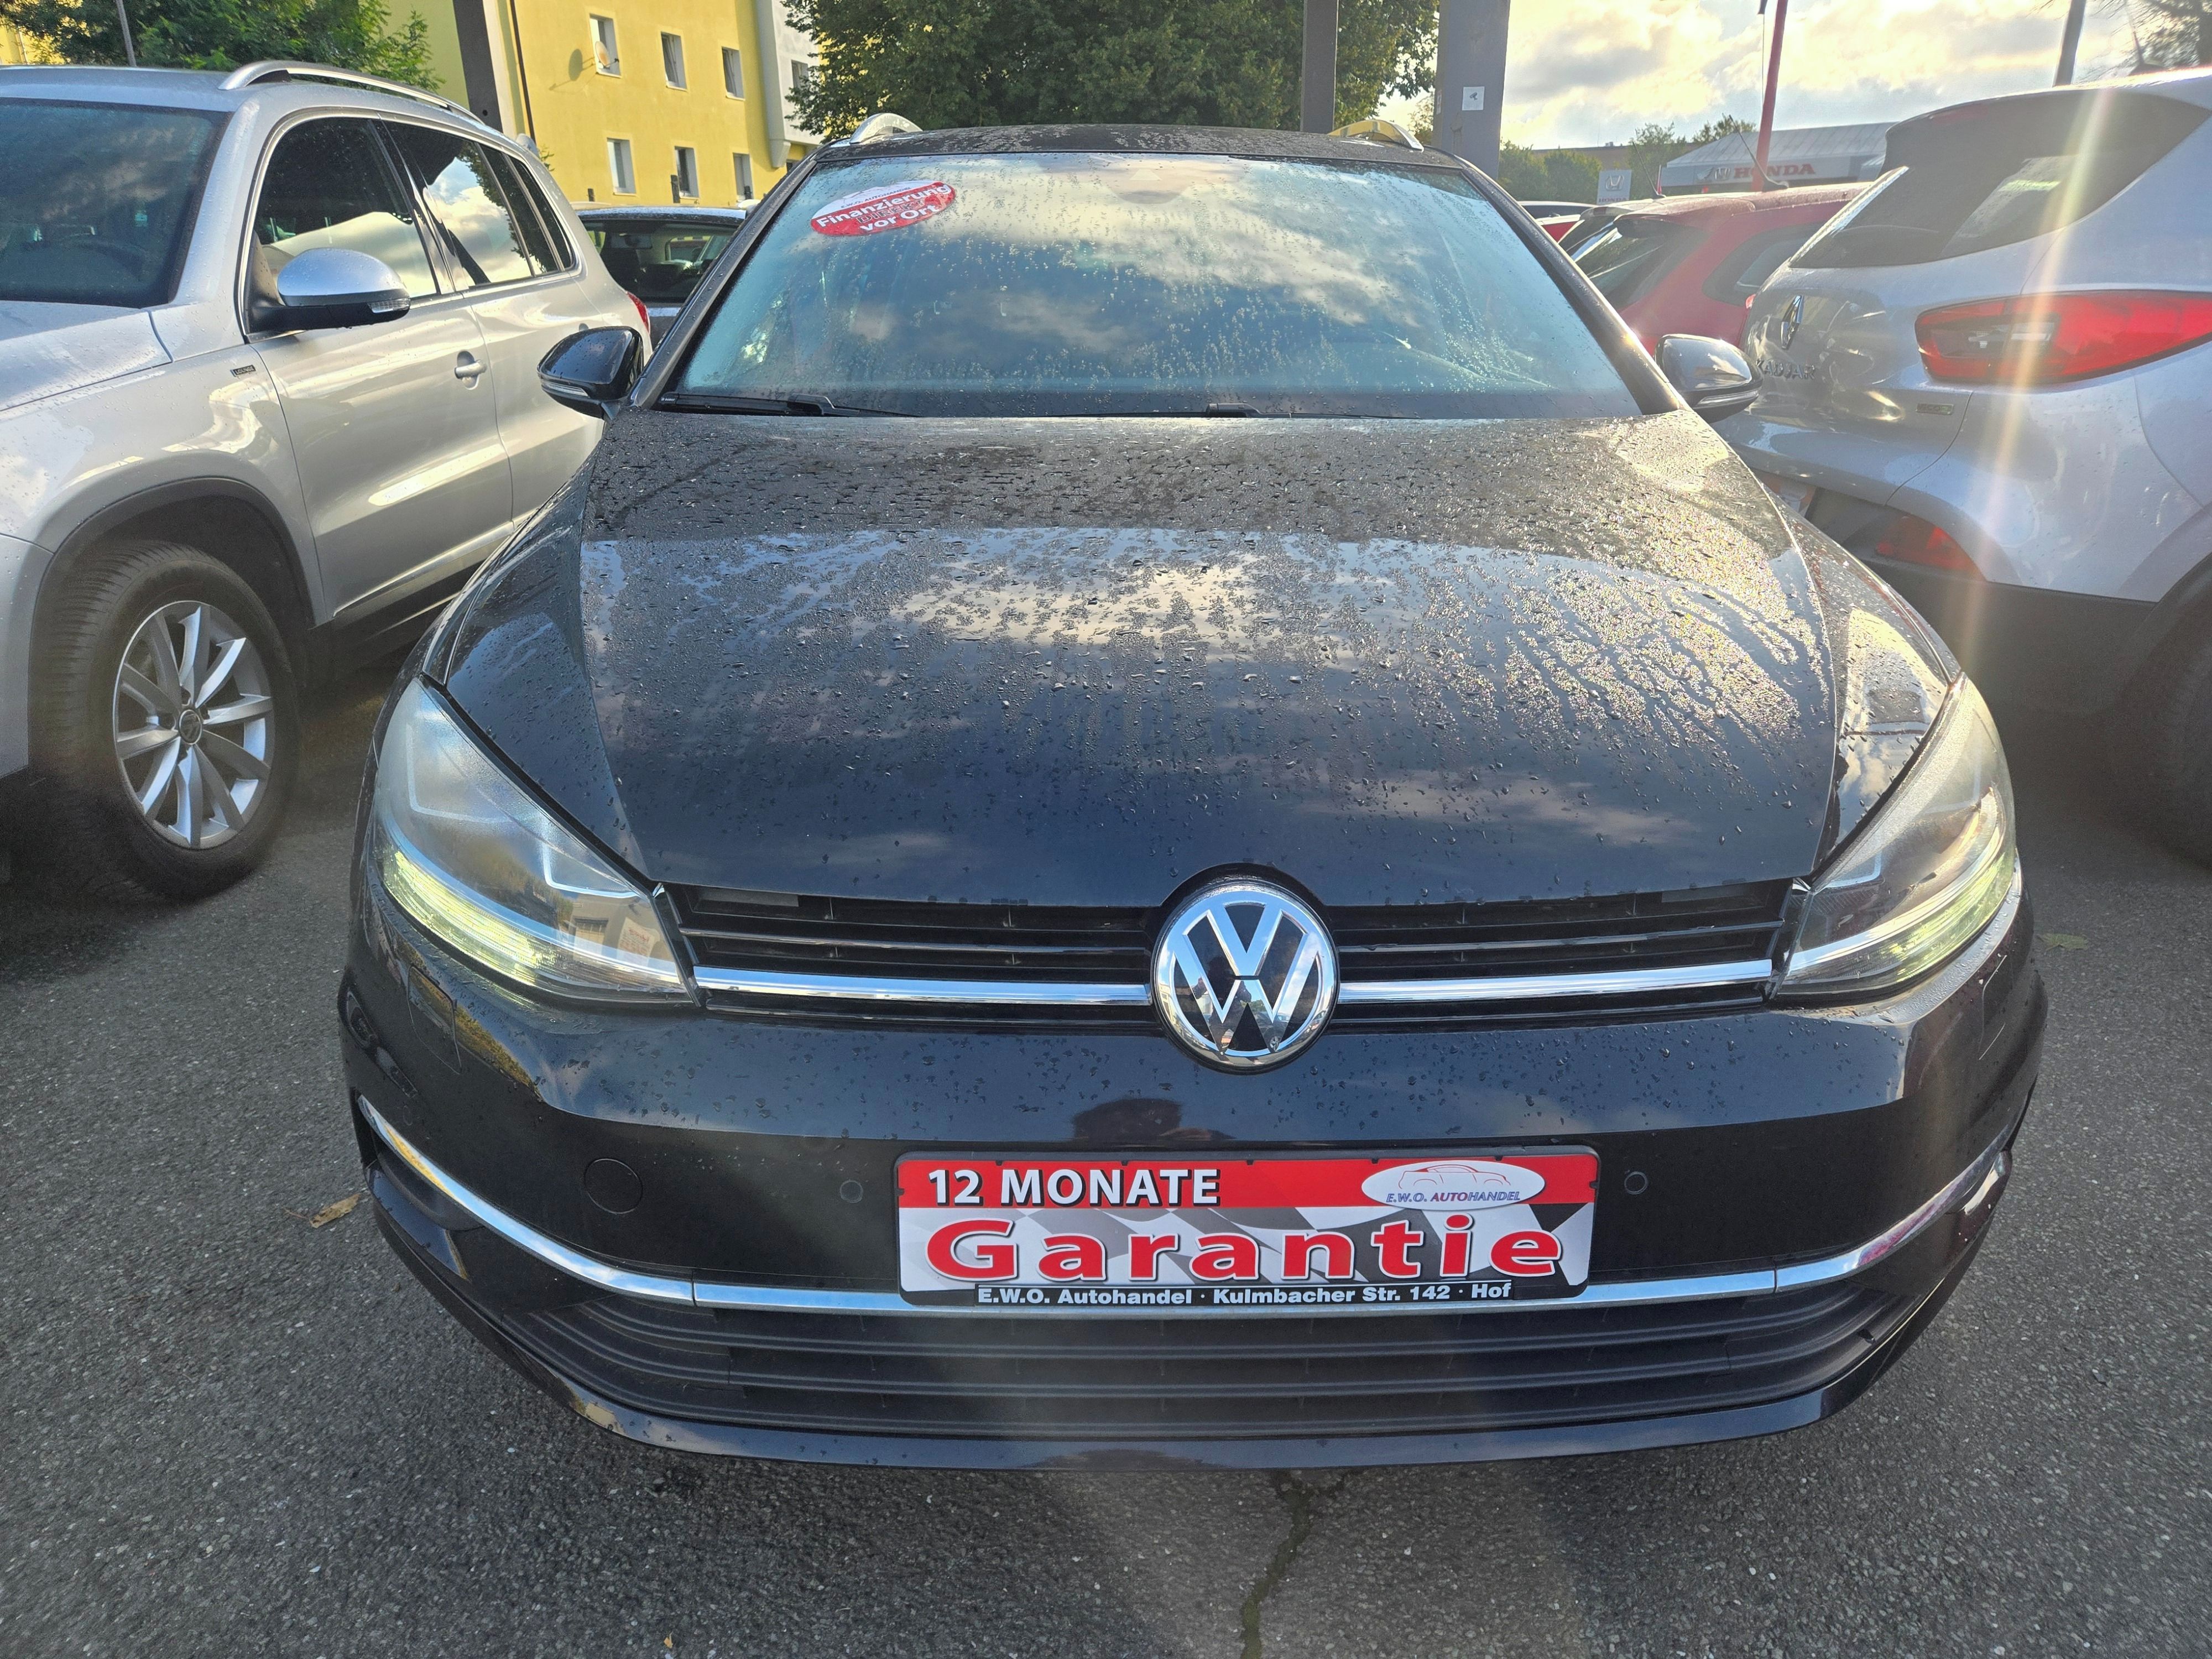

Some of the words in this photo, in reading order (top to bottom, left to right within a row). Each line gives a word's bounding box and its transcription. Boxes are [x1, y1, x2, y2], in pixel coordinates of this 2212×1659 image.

[1734, 164, 1815, 178] HNDA
[816, 184, 952, 227] Finanzierung
[857, 199, 925, 223] DIREKT
[859, 215, 896, 231] vor
[900, 204, 940, 220] Ort
[929, 1169, 982, 1206] 12
[1001, 1168, 1219, 1207] MONATE
[1386, 1192, 1427, 1203] E.W.O.
[1430, 1191, 1520, 1202] AUTOHANDEL
[925, 1213, 1563, 1282] Garantie
[978, 1288, 1050, 1303] E.W.O.
[1058, 1289, 1191, 1305] Autohandel
[1213, 1286, 1355, 1303] Kulmbacher
[1362, 1287, 1401, 1301] Str.
[1410, 1286, 1451, 1300] 142
[1471, 1282, 1512, 1298] Hof
